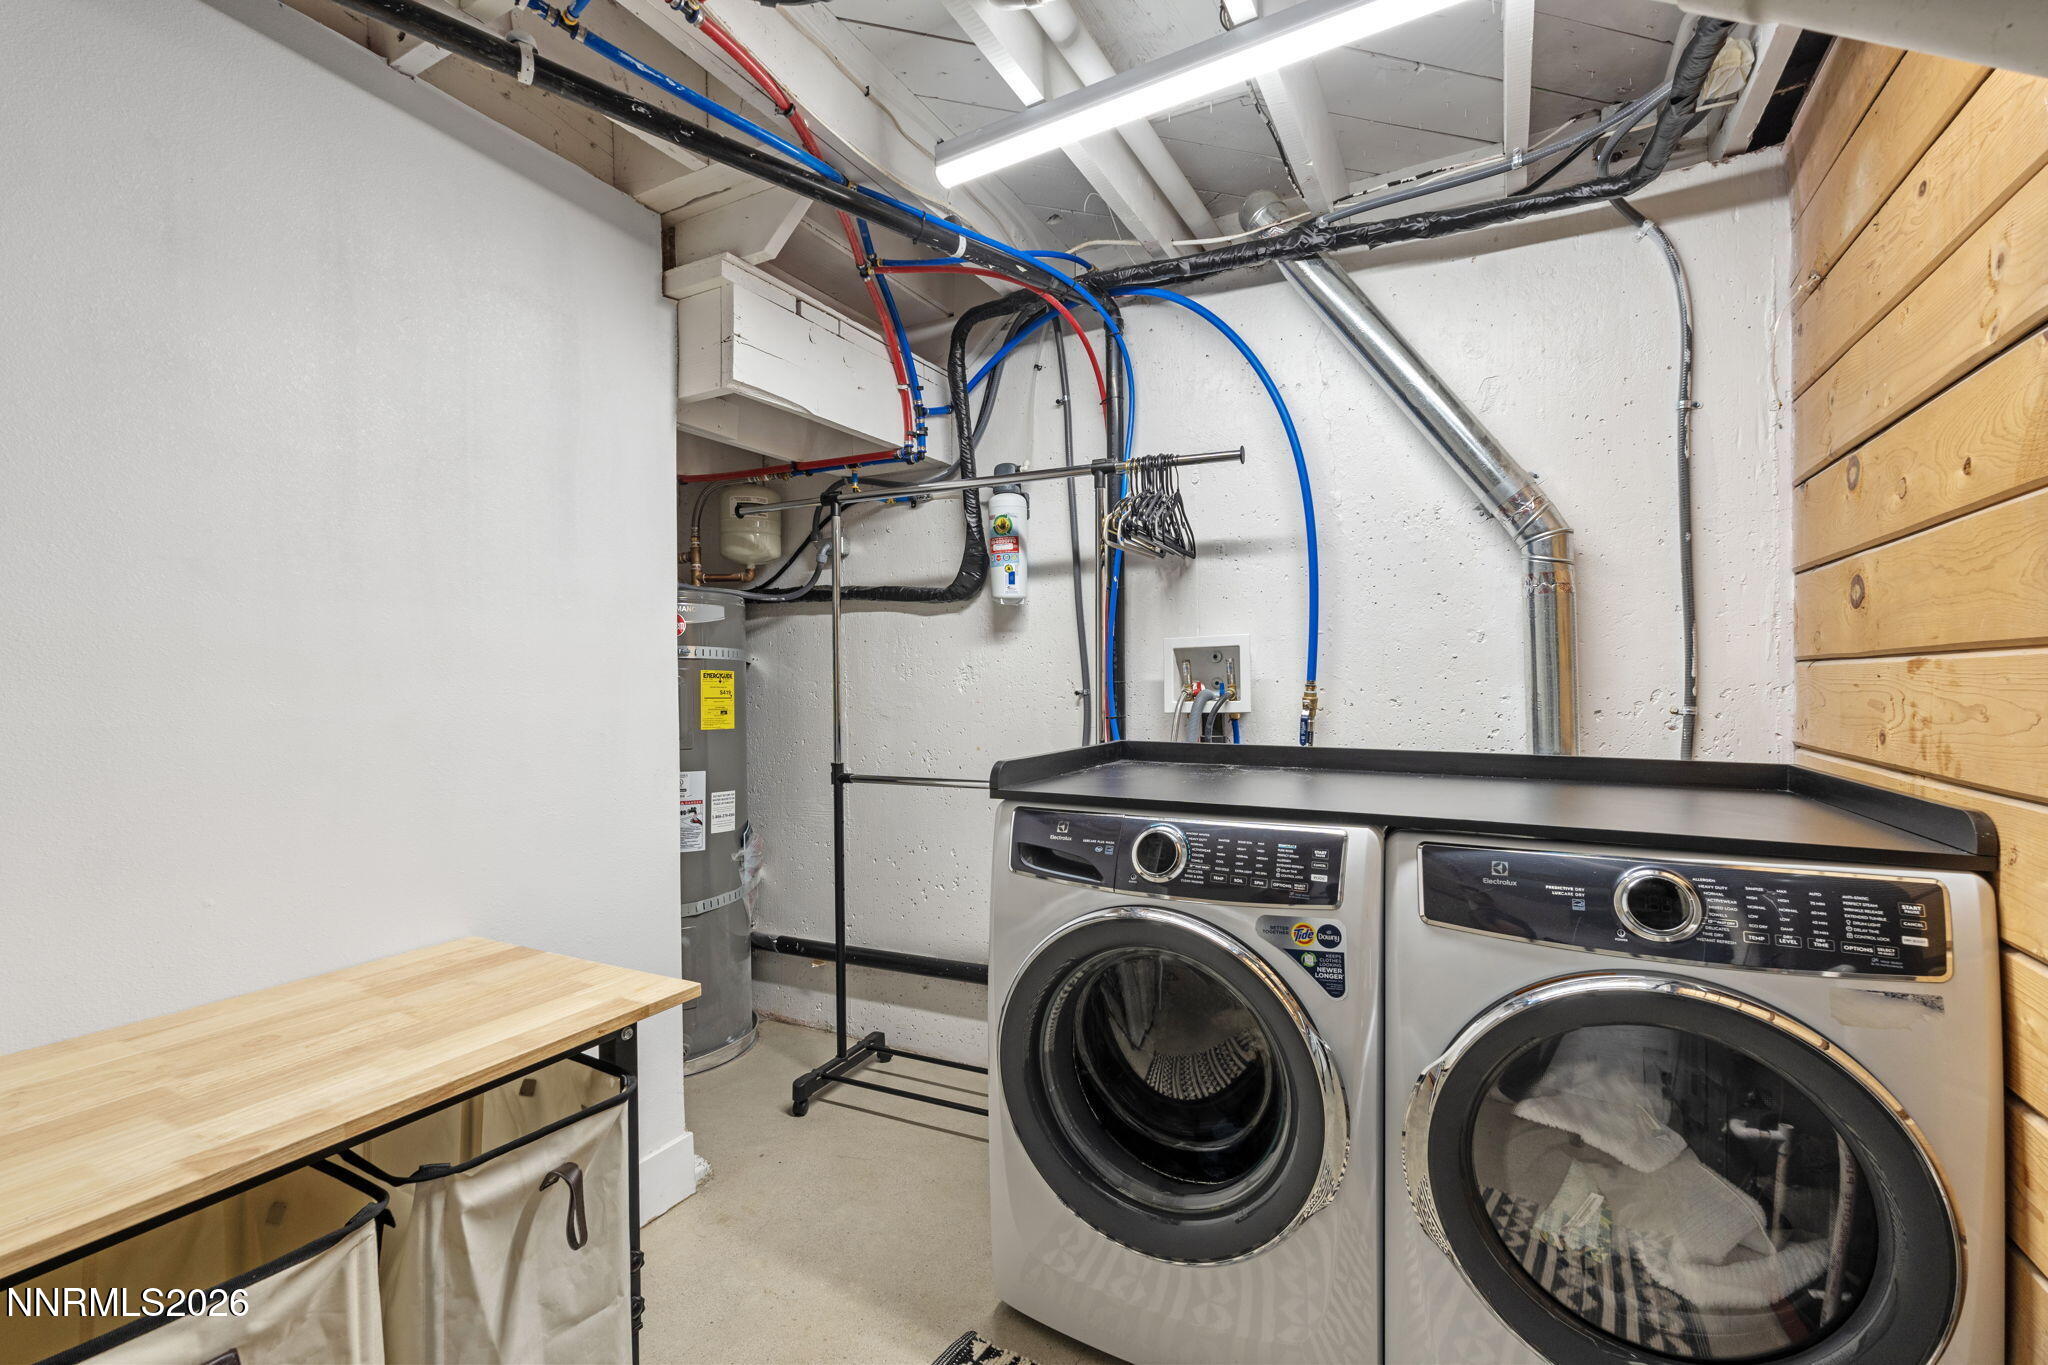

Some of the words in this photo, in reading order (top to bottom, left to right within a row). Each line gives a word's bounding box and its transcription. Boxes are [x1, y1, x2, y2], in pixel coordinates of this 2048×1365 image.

[1482, 877, 1518, 887] Electrolux
[1294, 928, 1314, 941] Tide
[1318, 933, 1340, 942] Downy
